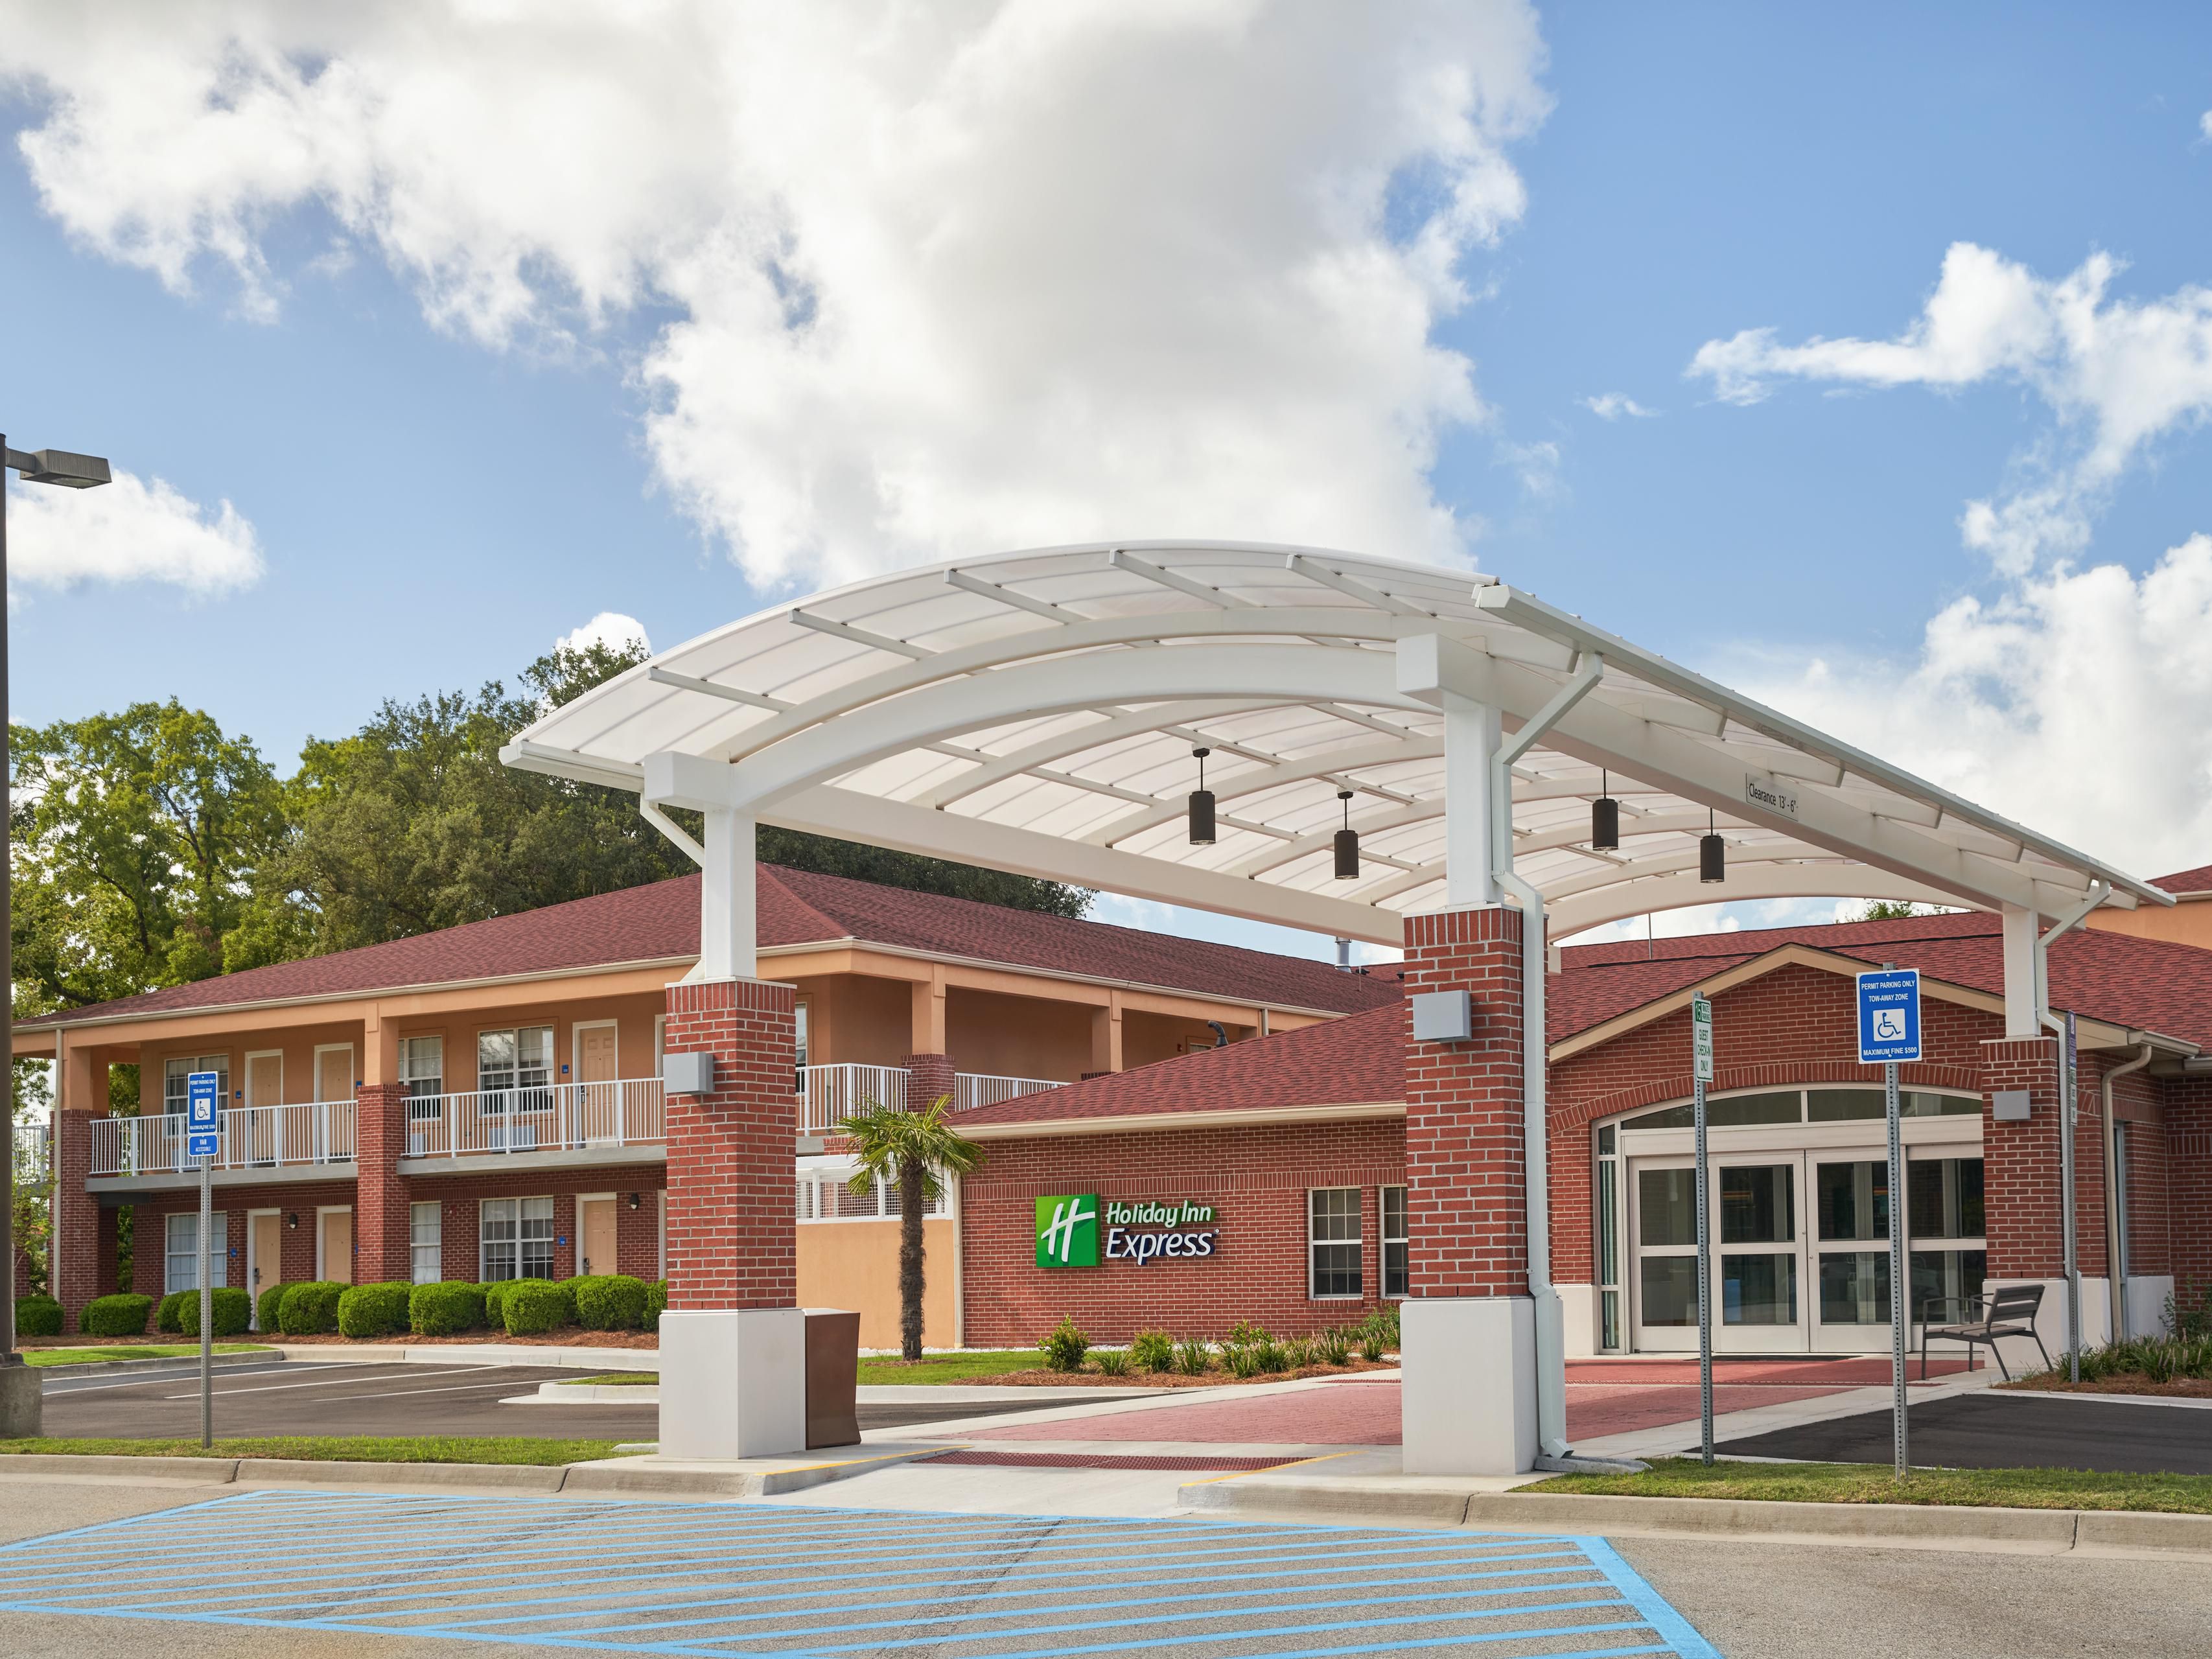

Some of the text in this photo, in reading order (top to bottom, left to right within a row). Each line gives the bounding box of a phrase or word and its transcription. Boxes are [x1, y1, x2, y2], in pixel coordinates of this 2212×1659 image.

[1749, 783, 1776, 806] Clearance
[1869, 994, 1894, 1003] TOW-AWAY
[1695, 1003, 1701, 1020] 15
[1699, 1028, 1708, 1041] GUEST
[1105, 1200, 1213, 1229] Holiday Inn
[1106, 1227, 1214, 1266] Express
